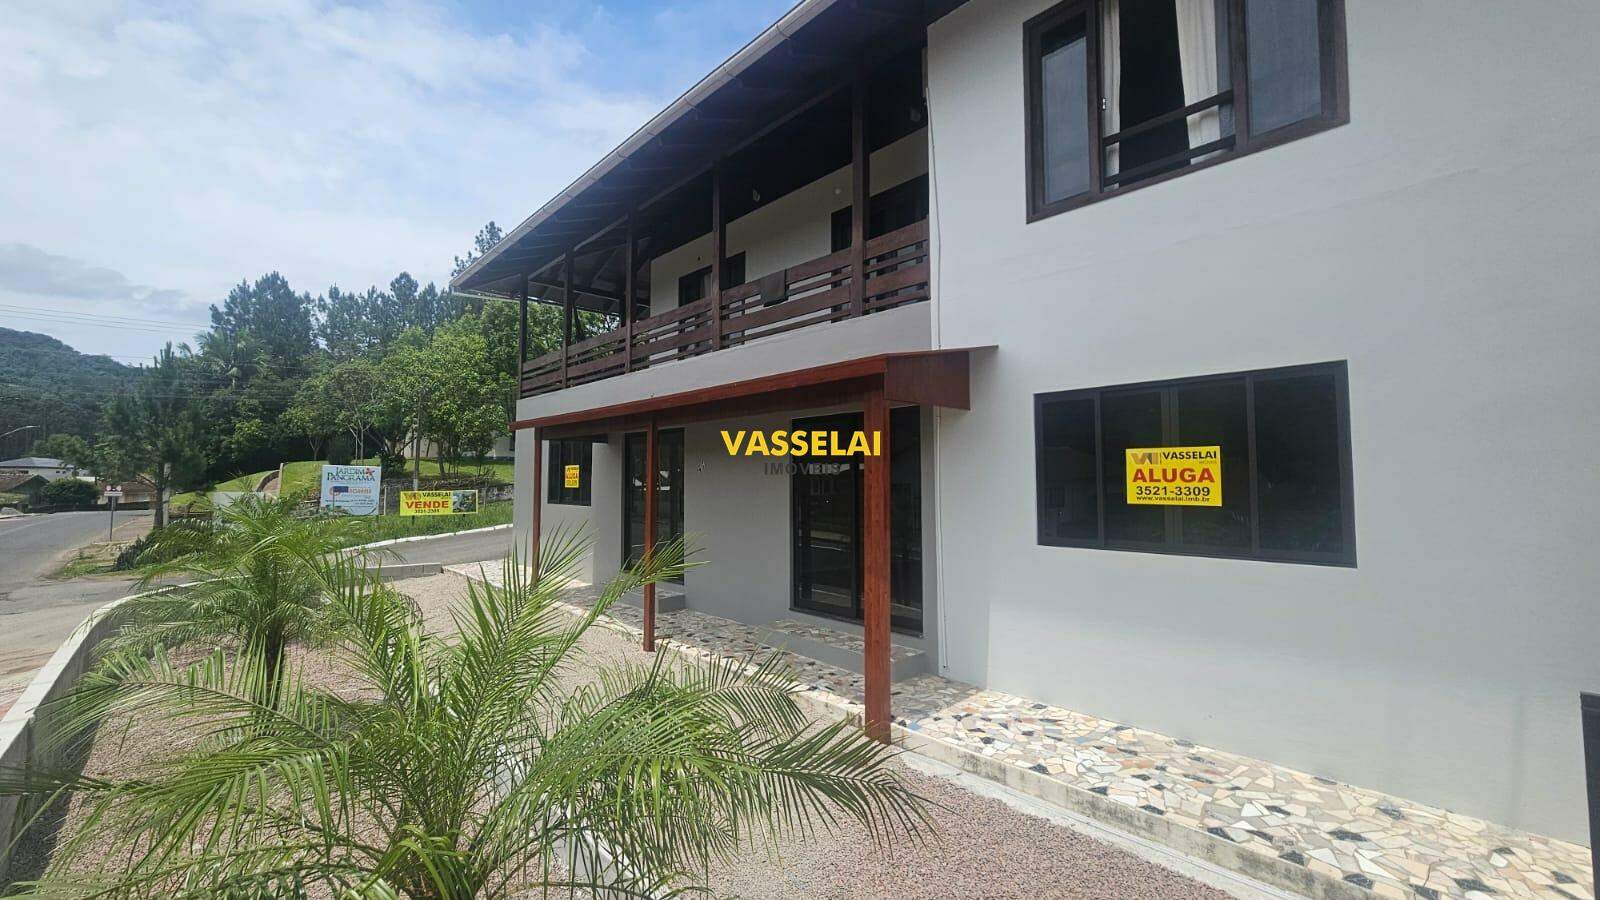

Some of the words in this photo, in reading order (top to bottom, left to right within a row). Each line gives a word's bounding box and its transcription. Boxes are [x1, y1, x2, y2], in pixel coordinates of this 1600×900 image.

[1162, 451, 1217, 460] VASSELAI
[1132, 467, 1215, 483] ALUGA
[1136, 485, 1210, 496] 3521-3309
[405, 501, 449, 509] VENDE
